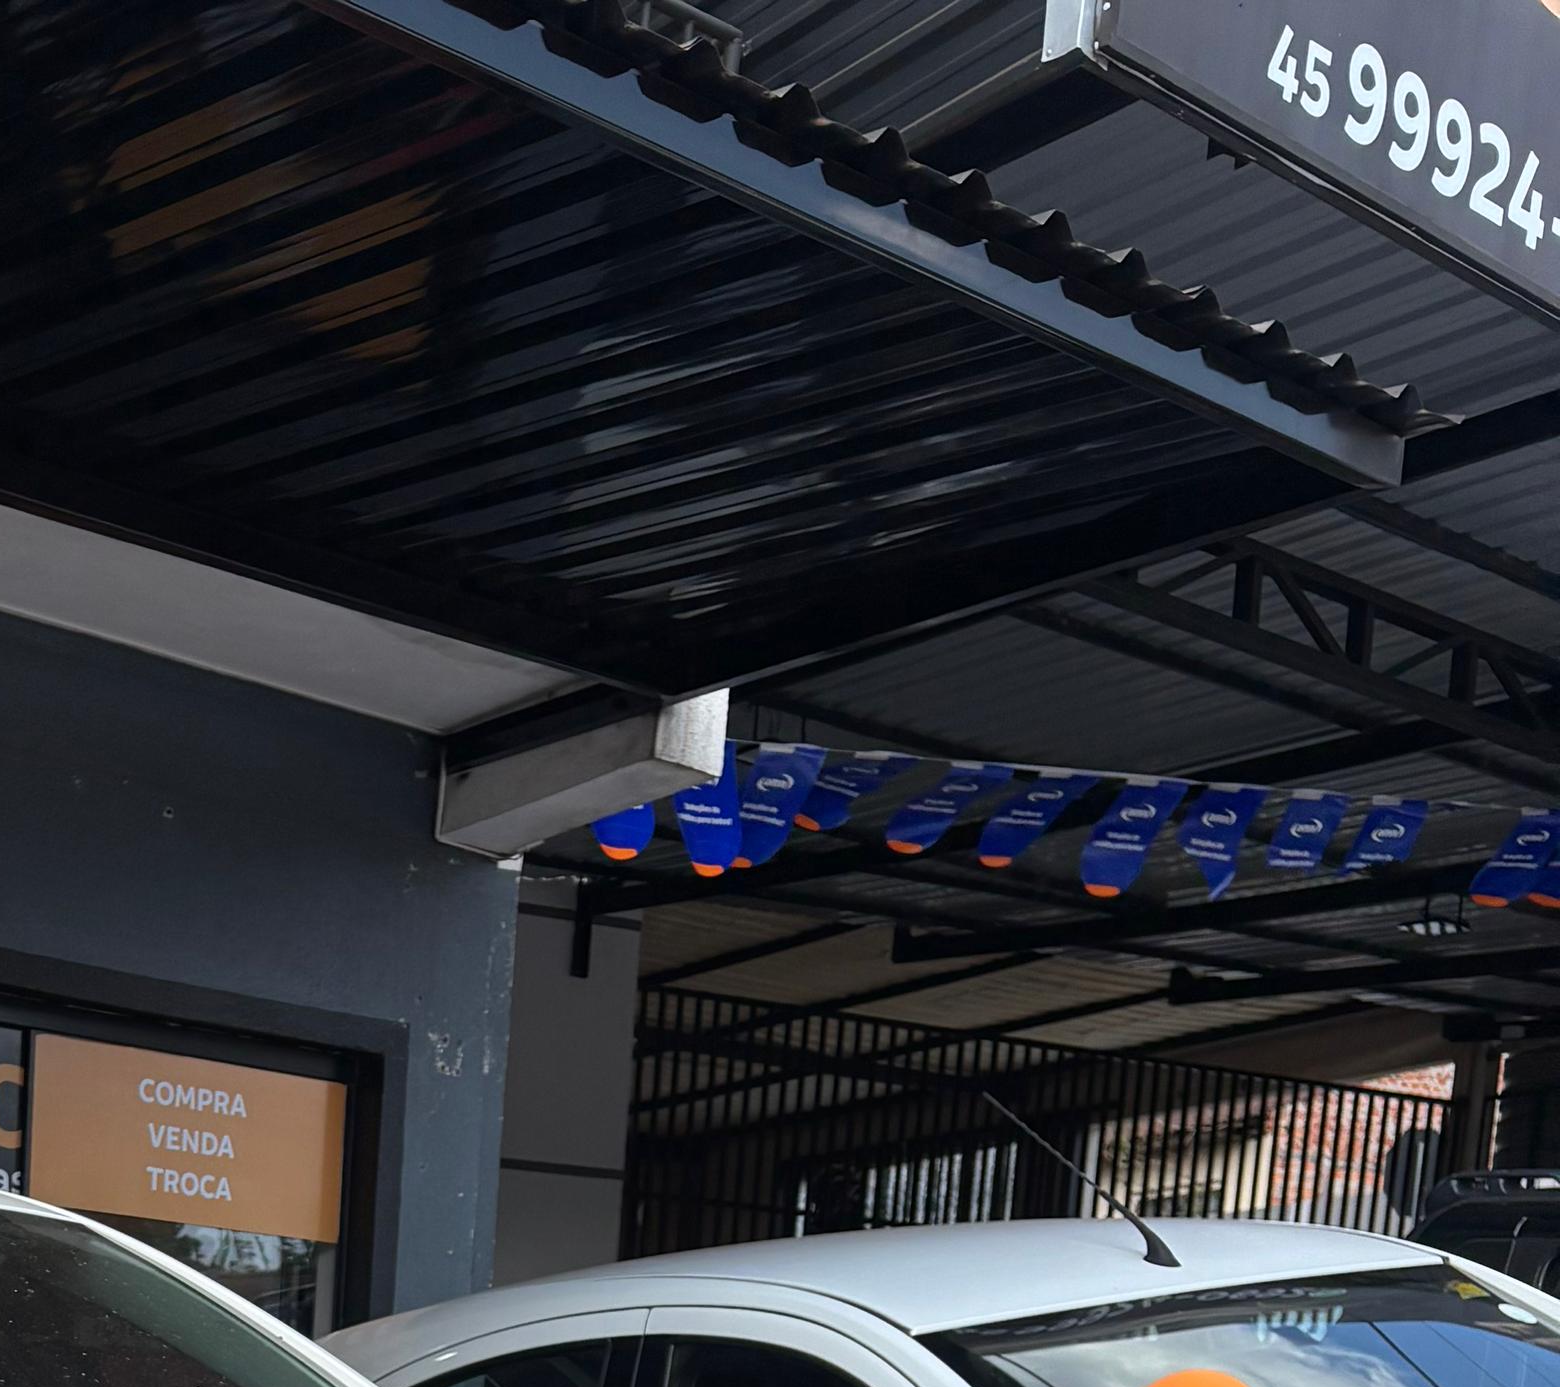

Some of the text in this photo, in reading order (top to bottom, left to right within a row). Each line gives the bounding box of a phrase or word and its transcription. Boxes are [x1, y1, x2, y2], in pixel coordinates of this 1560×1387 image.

[1267, 24, 1333, 118] 45
[139, 1076, 247, 1119] COMPRA
[148, 1123, 235, 1160] VENDA
[146, 1165, 233, 1202] TROCA
